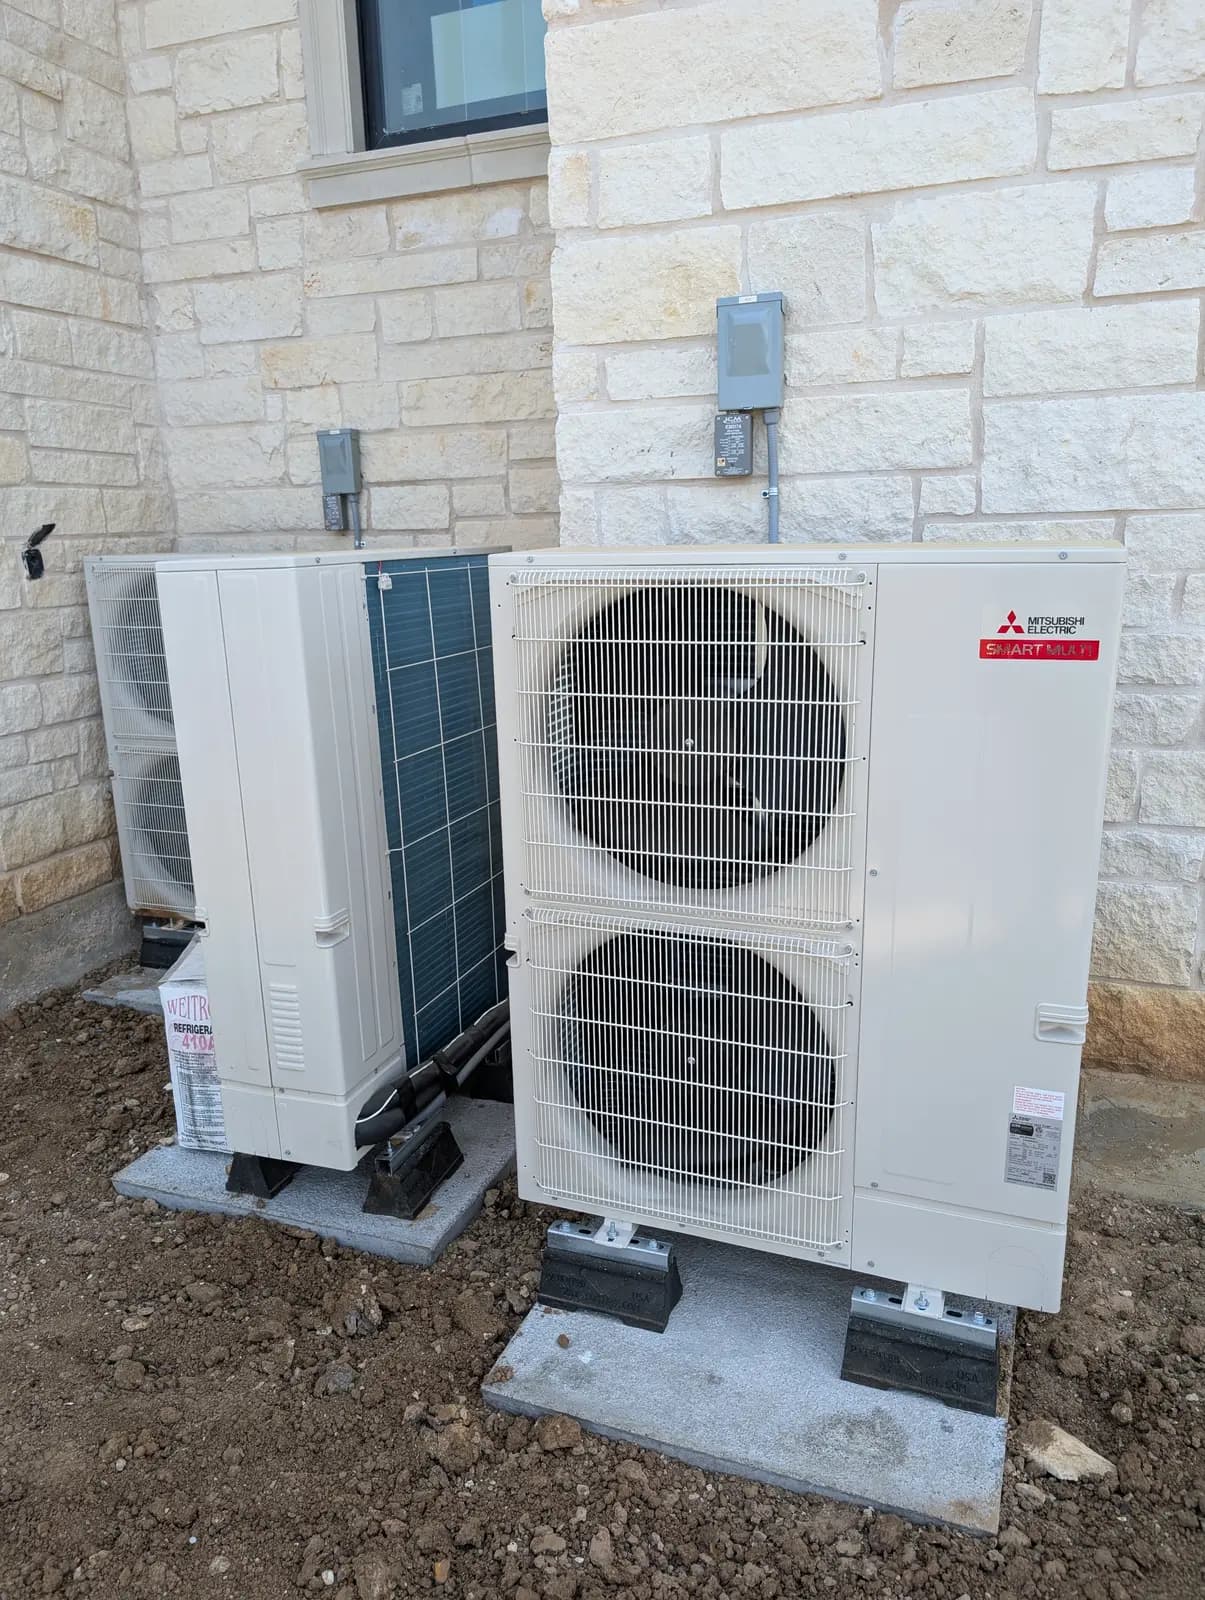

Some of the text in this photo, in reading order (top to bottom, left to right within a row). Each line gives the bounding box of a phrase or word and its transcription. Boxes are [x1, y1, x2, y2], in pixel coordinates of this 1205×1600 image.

[1027, 616, 1085, 626] MITSUBISHI
[1027, 626, 1077, 635] ELECTRIC
[986, 643, 1093, 657] SMART MULTI
[167, 995, 211, 1021] WEITR
